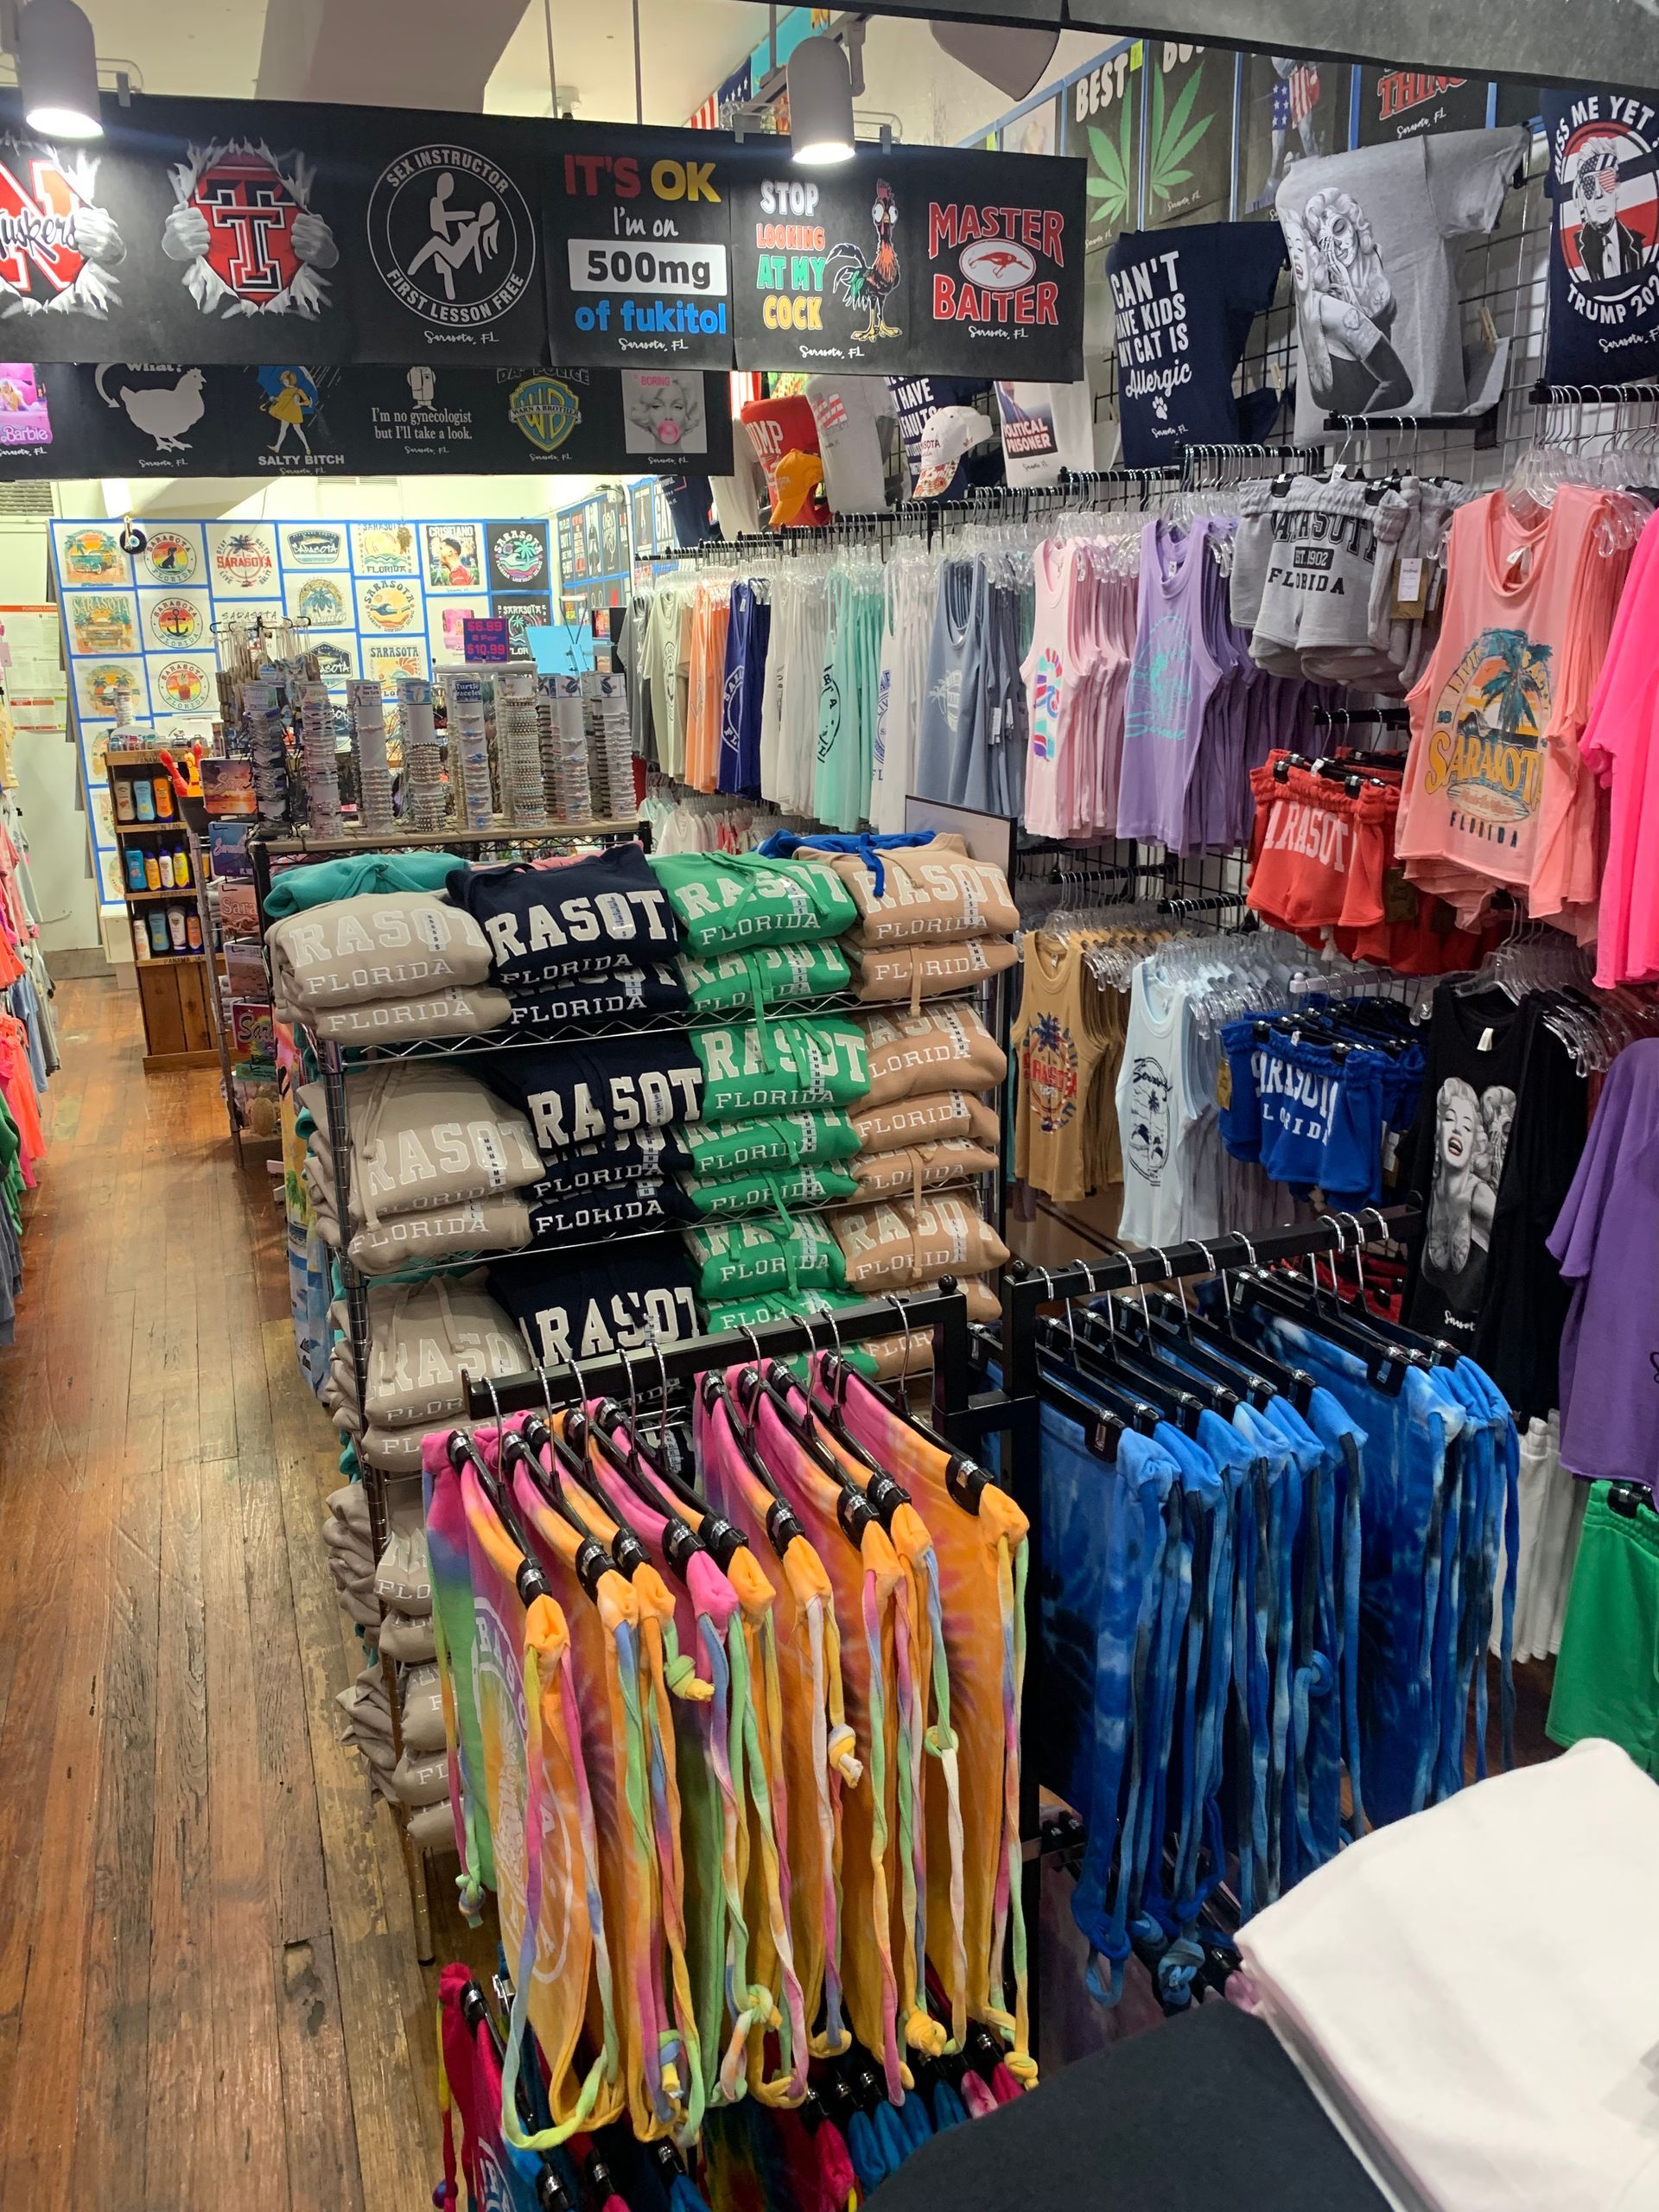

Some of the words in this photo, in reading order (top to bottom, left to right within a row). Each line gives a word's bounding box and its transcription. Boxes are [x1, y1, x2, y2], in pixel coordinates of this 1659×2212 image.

[1076, 53, 1128, 123] BEST
[1434, 107, 1446, 120] FL
[1571, 96, 1599, 127] ME
[386, 158, 415, 188] SEX
[415, 149, 510, 194] INSTRUCTOR
[563, 154, 641, 199] IT'S
[651, 159, 721, 203] OK
[760, 179, 820, 216] STOP
[613, 206, 646, 235] I'm
[652, 219, 679, 238] on
[929, 202, 1065, 268] MASTER
[756, 223, 825, 251] LOOKING
[588, 250, 710, 289] 500mg
[757, 255, 786, 290] AT
[791, 257, 827, 291] MY
[1110, 251, 1179, 309] CAN'T
[386, 269, 429, 311] FIRST
[430, 304, 493, 323] LESSON
[492, 273, 524, 311] FREE
[933, 274, 1059, 325] BAITER
[1567, 283, 1626, 325] TRUMP
[575, 300, 611, 332] of
[621, 300, 726, 334] fukitol
[762, 295, 823, 330] COCK
[1141, 292, 1187, 331] KIDS
[480, 332, 499, 344] FL
[671, 339, 690, 350] FL
[1014, 327, 1029, 339] FL
[1135, 330, 1162, 364] CAT
[1169, 322, 1189, 353] IS
[848, 347, 865, 359] FL
[641, 375, 671, 386] BORING
[899, 378, 934, 406] HAVE
[1125, 358, 1192, 400] Allergic
[372, 407, 391, 423] I'm
[394, 410, 408, 423] no
[410, 409, 473, 426] gynecologist
[512, 406, 534, 416] WARN
[543, 404, 580, 417] BROTHER
[1, 426, 48, 442] Barbie
[375, 426, 392, 440] but
[396, 425, 411, 440] I'll
[414, 425, 435, 440] take
[439, 429, 446, 440] a
[448, 425, 473, 440] look.
[258, 455, 300, 467] SALTY
[305, 454, 345, 466] BITCH
[146, 534, 192, 553] SARASOTA
[429, 525, 474, 537] CRISTIANO
[494, 530, 543, 554] SARASOTA
[152, 568, 194, 583] FLORIDA
[216, 556, 273, 569] SARASOTA
[366, 565, 407, 574] FLORIDA
[364, 580, 416, 604] SARASOTA
[1268, 567, 1345, 595] FLORIDA
[73, 596, 129, 618] SARASOTA
[154, 601, 199, 619] SARASOTA
[159, 632, 200, 648] FLORIDA
[371, 646, 420, 658] SARASOTA
[162, 664, 205, 682] SARASOTA
[165, 695, 207, 711] FLORIDA
[1448, 814, 1519, 849] FLORIDA
[289, 907, 484, 968] RASOT
[484, 888, 666, 967] RASOT
[700, 913, 821, 945] FLORIDA
[308, 959, 455, 995] FLORIDA
[500, 954, 633, 984] FLORIDA
[875, 958, 991, 981] FLRIDA
[327, 1001, 474, 1033] FLORIDA
[512, 995, 647, 1025] FLORIDA
[527, 1067, 702, 1150] RASOT
[715, 1090, 836, 1109] FLORIDA
[533, 1163, 665, 1199] FLORIDA
[536, 1199, 665, 1236] FLORIDA
[351, 1217, 489, 1255] FLORIDA
[721, 1254, 830, 1282] FLORDA
